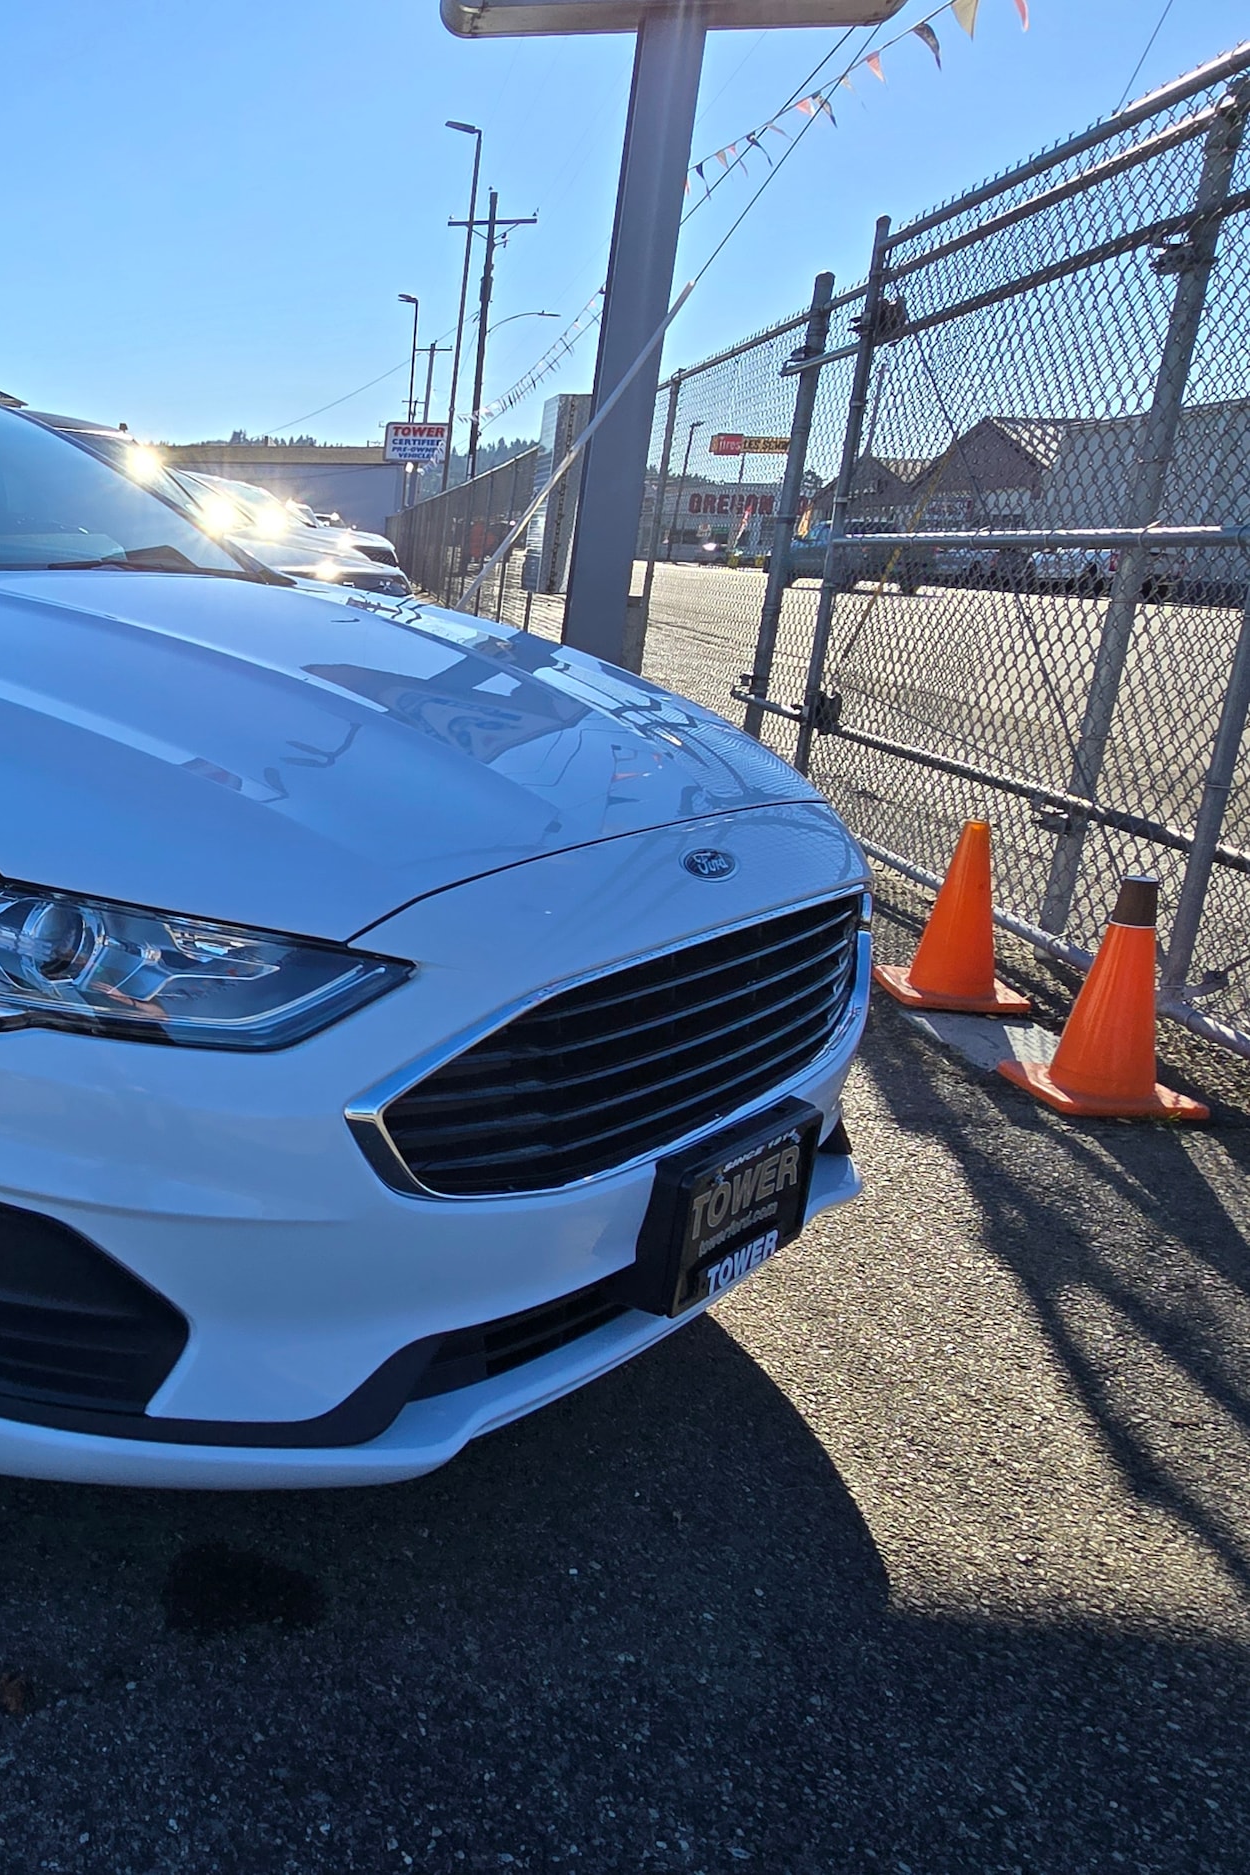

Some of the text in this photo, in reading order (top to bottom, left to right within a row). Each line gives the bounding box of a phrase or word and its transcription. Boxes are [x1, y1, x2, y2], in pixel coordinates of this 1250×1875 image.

[393, 426, 445, 438] TOWER
[688, 493, 775, 515] OREGON
[692, 852, 729, 875] Ford
[723, 1145, 765, 1173] SINCE
[692, 1144, 800, 1241] TOWER
[707, 1229, 779, 1296] TOWER
